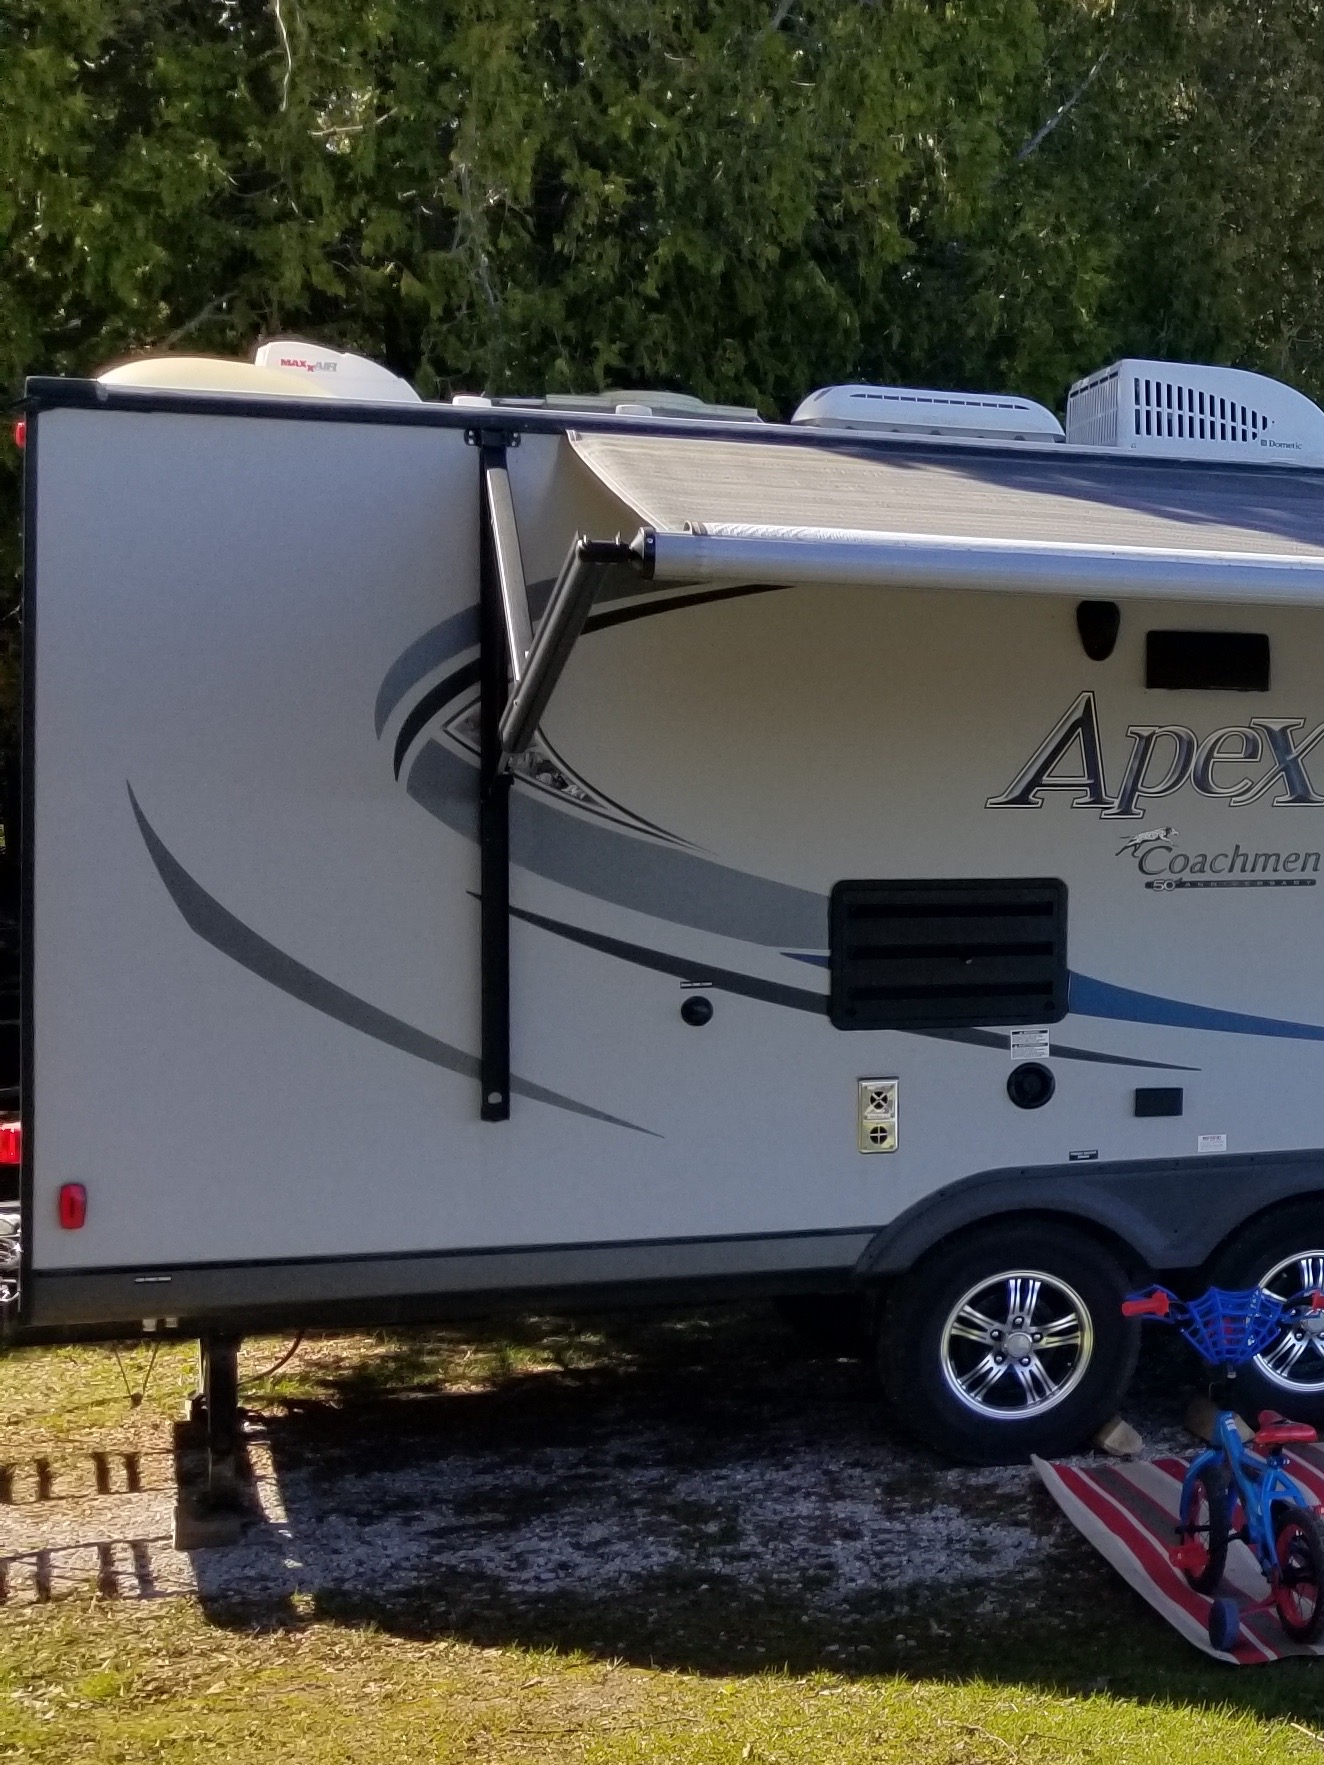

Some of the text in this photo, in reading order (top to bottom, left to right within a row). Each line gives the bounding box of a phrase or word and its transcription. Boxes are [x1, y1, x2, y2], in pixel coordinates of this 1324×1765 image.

[1269, 439, 1302, 450] Dometic
[1138, 845, 1321, 875] Coachmen
[1152, 879, 1176, 893] 50
